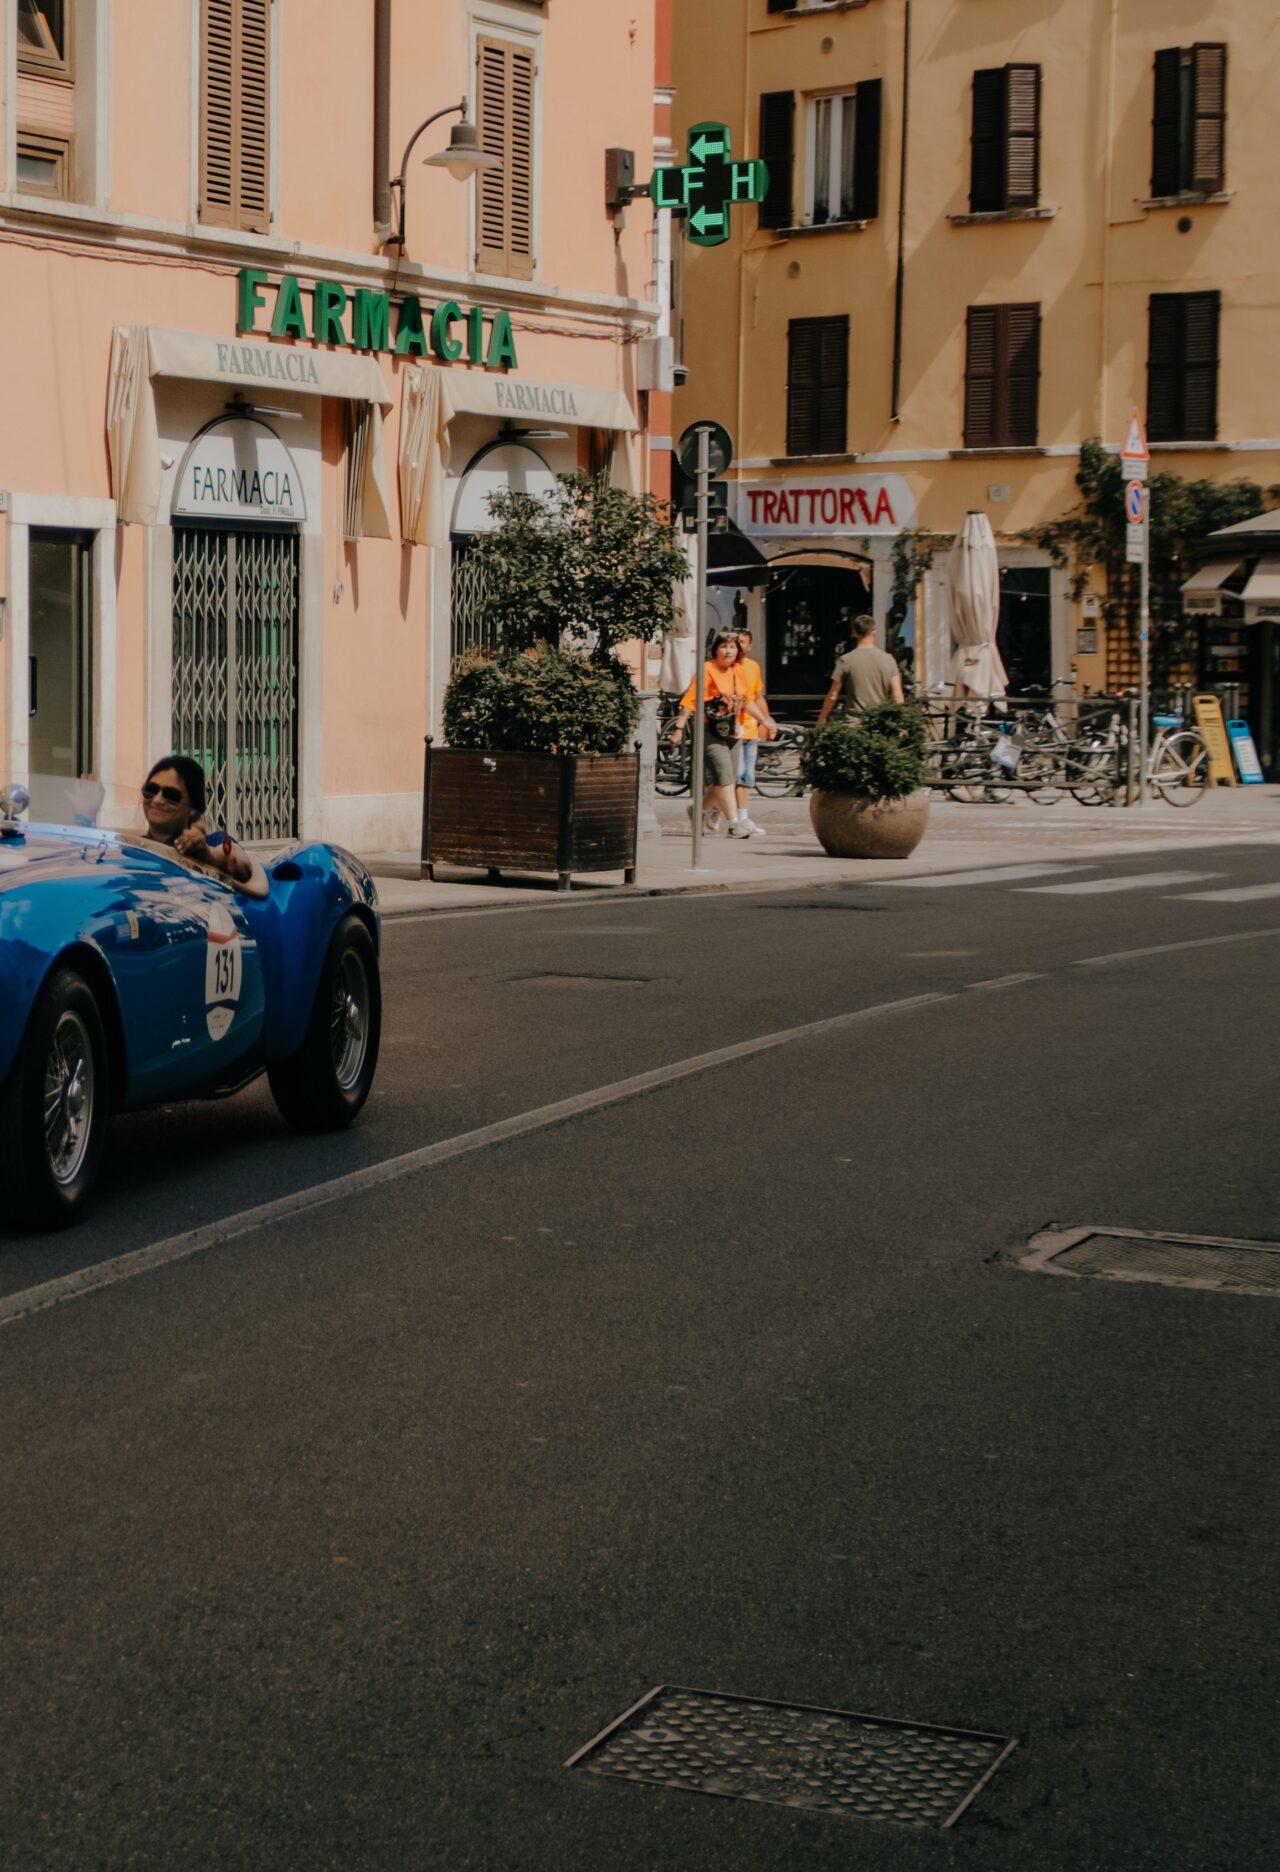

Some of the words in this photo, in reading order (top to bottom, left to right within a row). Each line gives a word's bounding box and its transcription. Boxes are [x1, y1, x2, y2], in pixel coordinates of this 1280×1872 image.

[237, 268, 519, 370] FARMACIA
[216, 342, 320, 385] FARMACIA
[494, 381, 579, 418] FARMACIA
[193, 466, 294, 506] FARMACIA
[747, 487, 896, 526] TRATTORIA
[215, 949, 234, 994] 131
